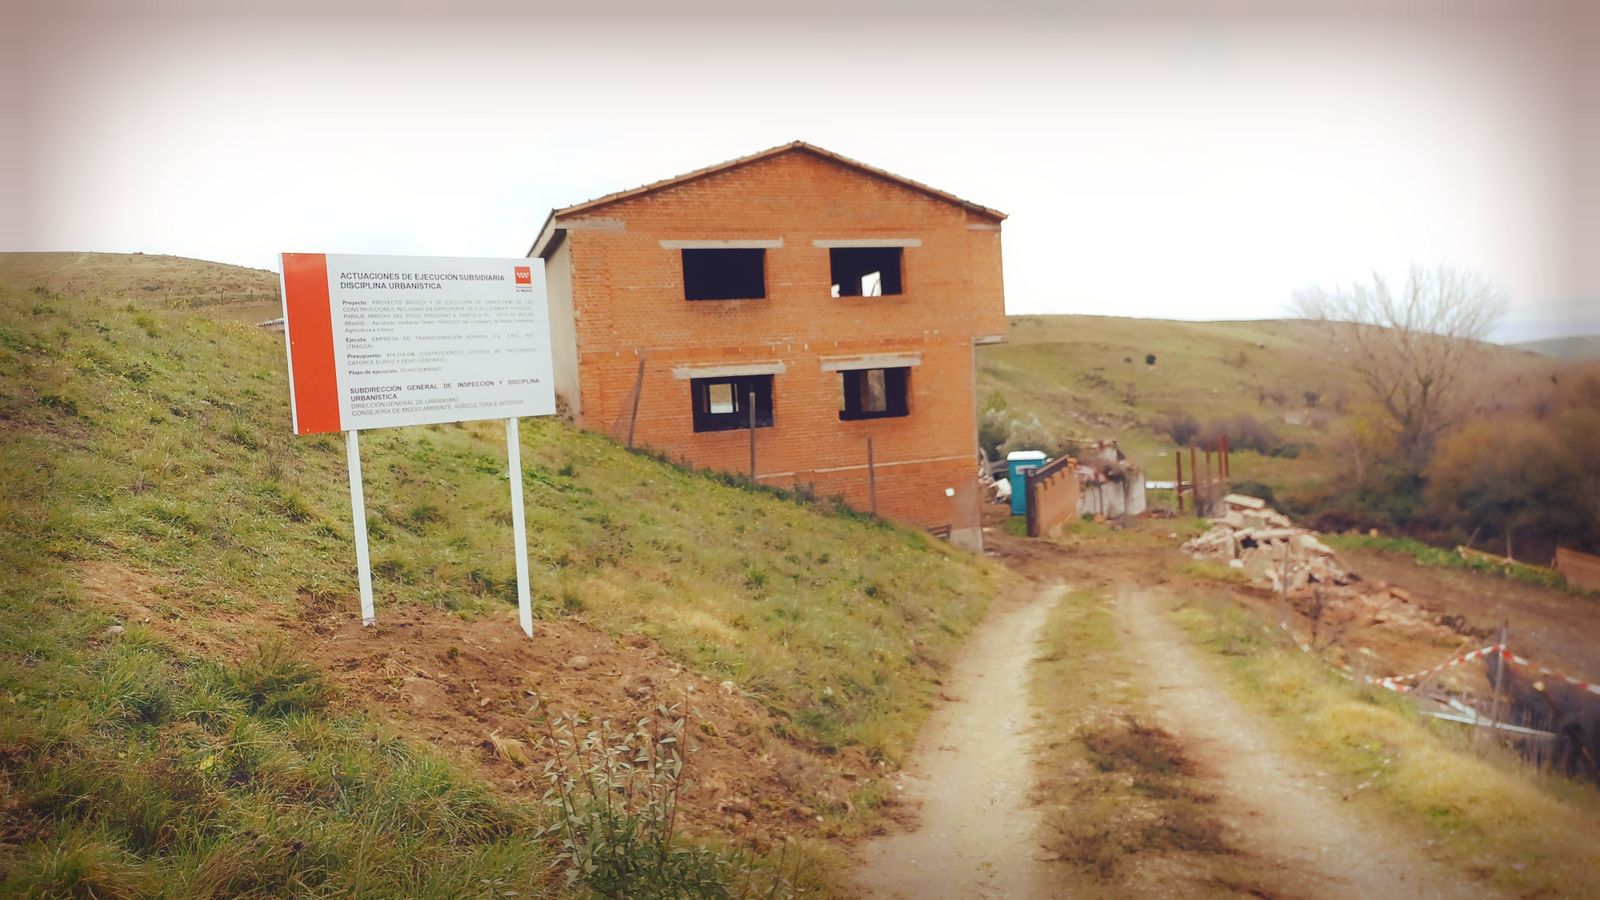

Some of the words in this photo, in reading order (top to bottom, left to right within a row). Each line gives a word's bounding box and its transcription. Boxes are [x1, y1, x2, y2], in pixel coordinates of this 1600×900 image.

[340, 272, 400, 280] ACTUACIONES
[350, 384, 402, 394] SUBDIRECCIÓN
[407, 383, 438, 391] GENERAL
[457, 380, 494, 388] INSPECCIÓN
